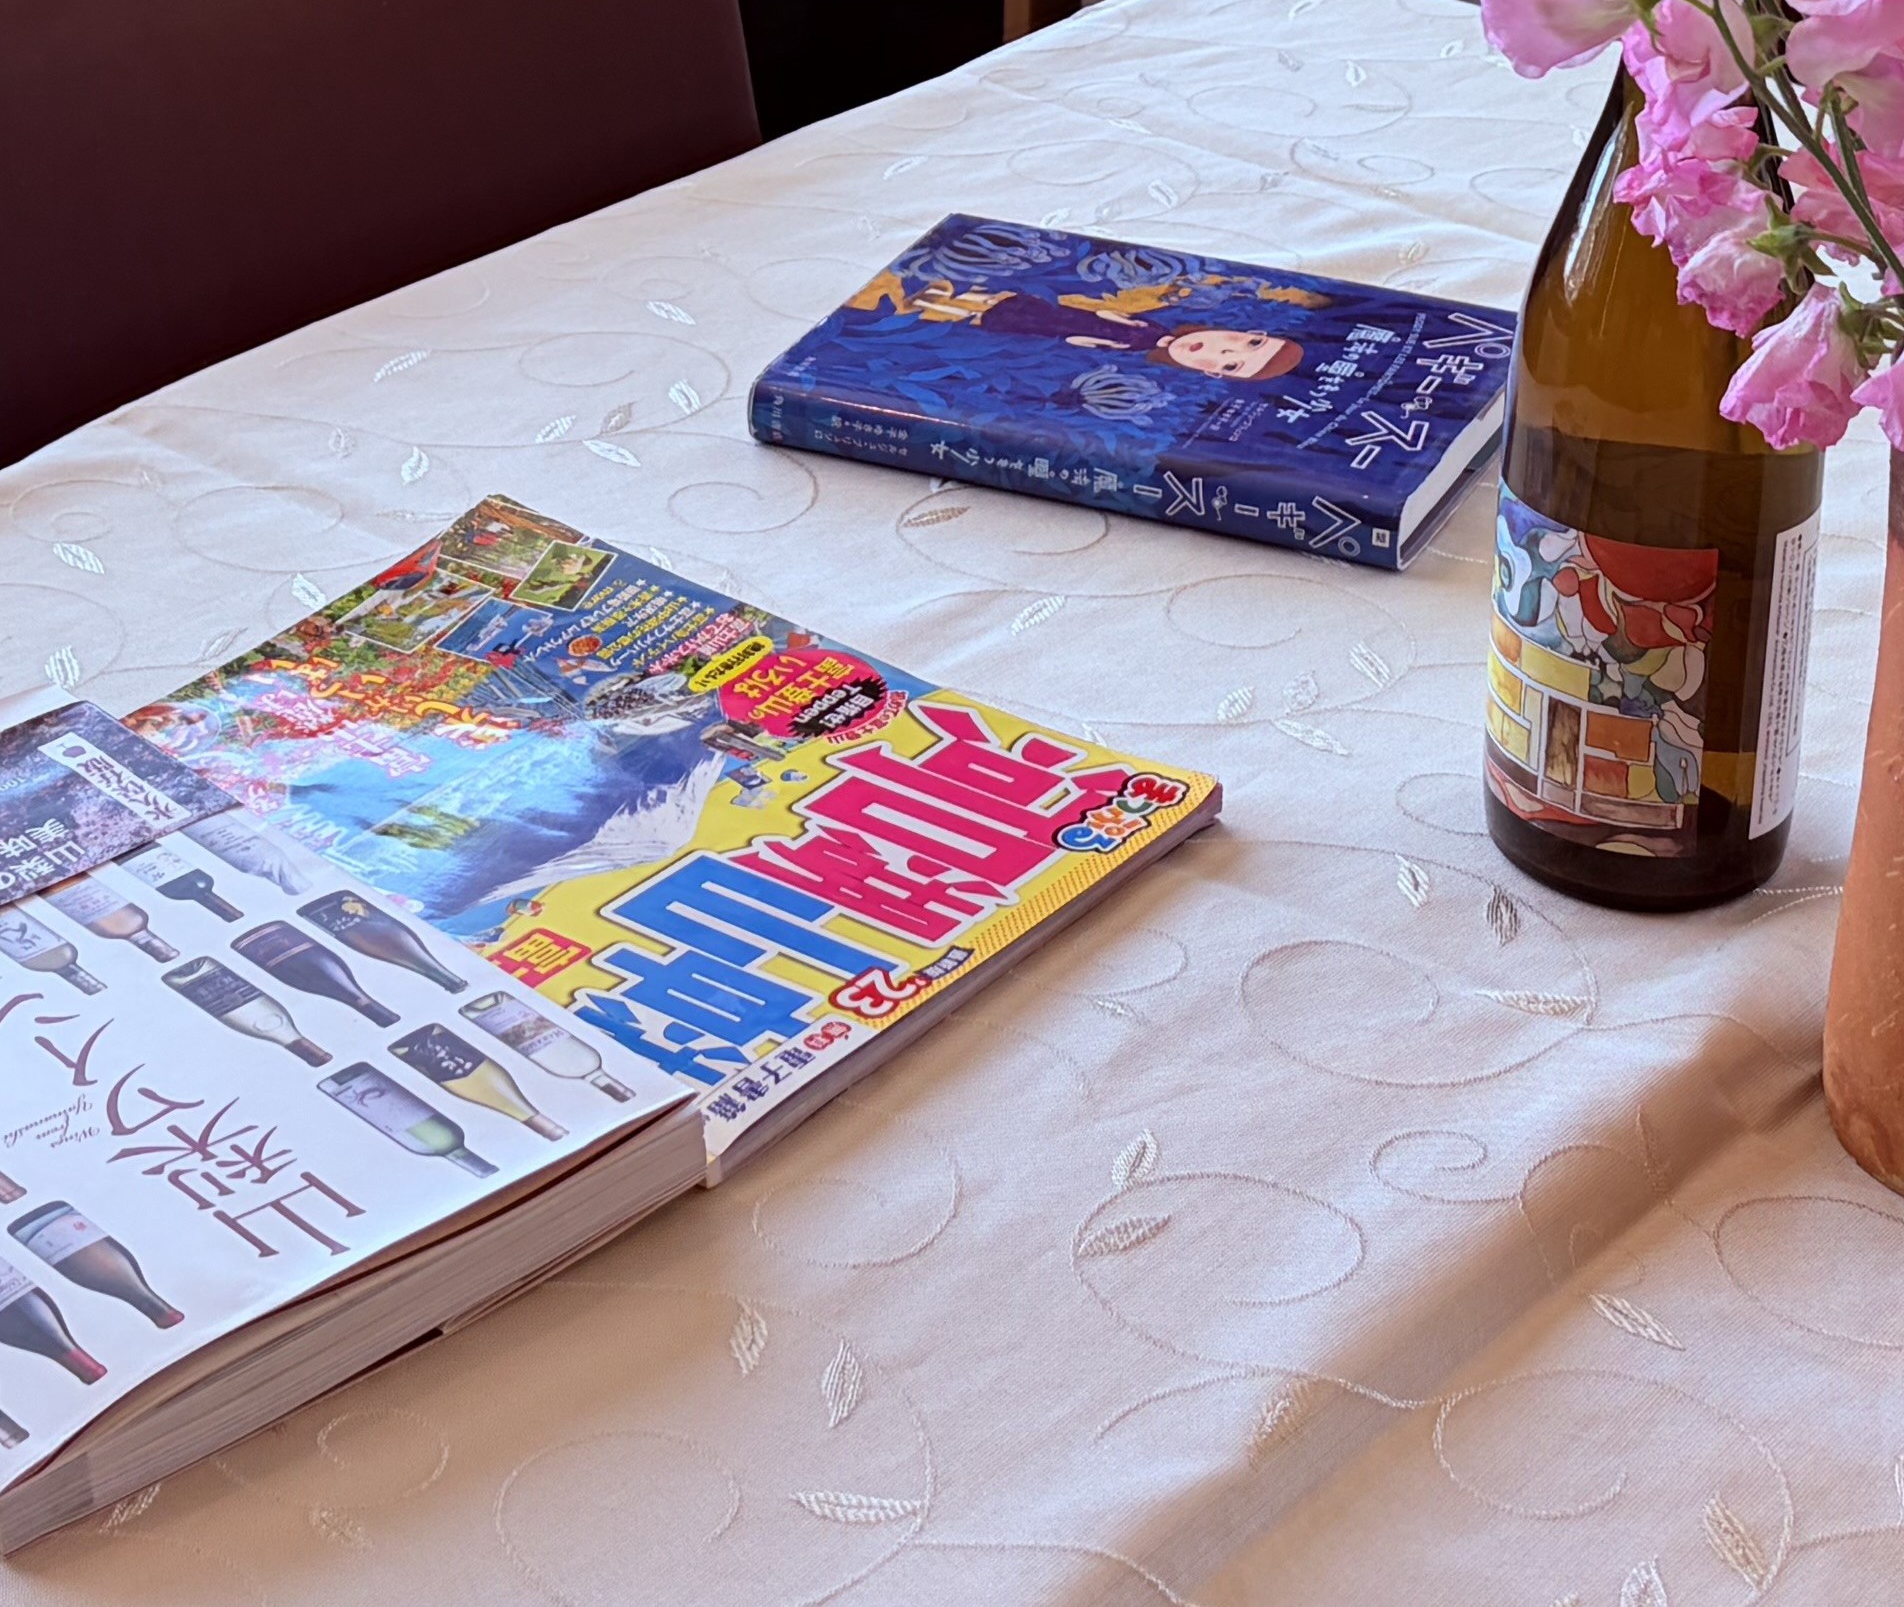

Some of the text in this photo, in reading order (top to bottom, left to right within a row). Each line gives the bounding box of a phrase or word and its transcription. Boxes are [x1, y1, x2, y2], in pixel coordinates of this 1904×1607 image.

[1276, 321, 1395, 429] 魔法の瞳をもつ少女
[1350, 407, 1430, 470] スー
[929, 440, 1363, 559] ペギー スー 魔法の瞳をもつ少女
[604, 606, 697, 668] 富士サファリパーク
[626, 612, 711, 668] 富士急ハイランド
[692, 639, 767, 689] 絶対行きたい!
[728, 651, 809, 702] いろは
[743, 653, 857, 728] 富士登山の
[789, 679, 863, 727] Teppen
[816, 691, 876, 730] 目指せ!
[69, 753, 187, 825] 永久保存版
[1055, 768, 1189, 856] まっぷる
[919, 944, 969, 980] 最新版
[46, 1121, 102, 1156] Wines
